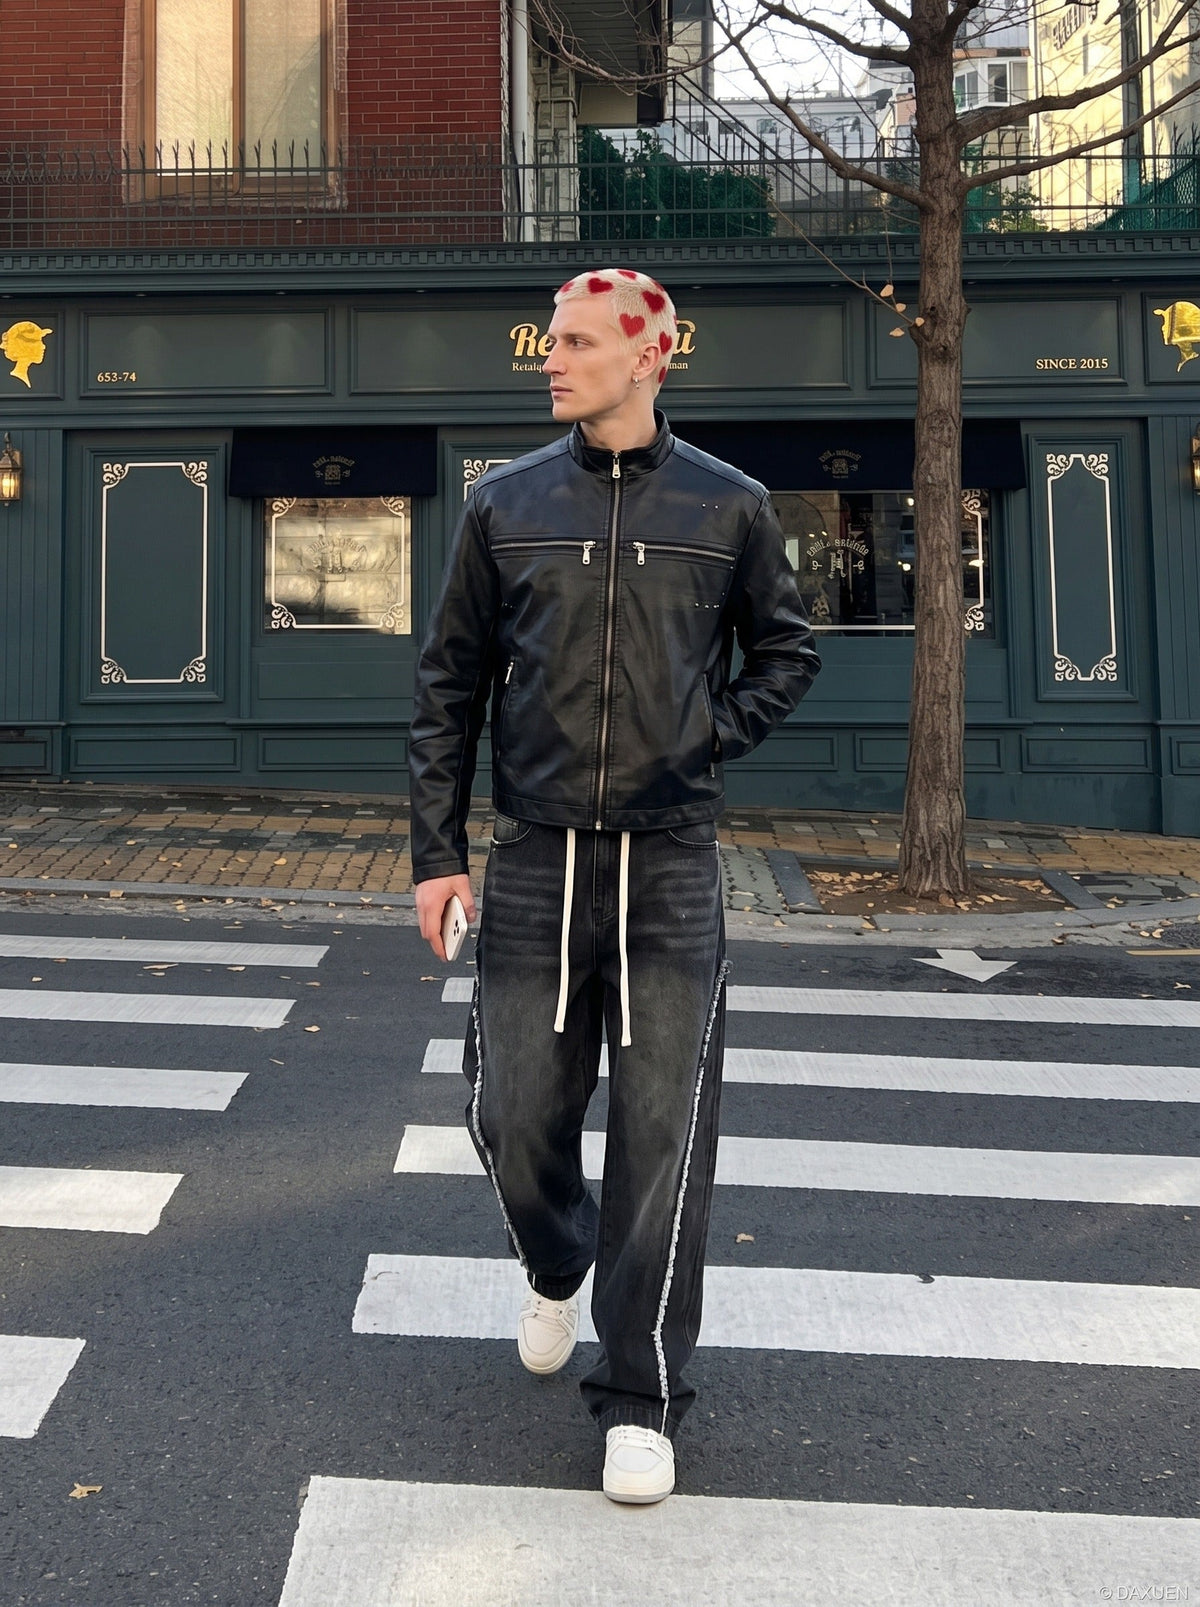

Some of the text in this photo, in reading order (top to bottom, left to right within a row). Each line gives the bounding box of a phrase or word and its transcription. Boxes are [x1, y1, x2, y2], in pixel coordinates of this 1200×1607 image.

[509, 322, 551, 357] Re
[512, 361, 689, 374] Retalq man
[1036, 358, 1109, 370] SINCE 2015
[97, 371, 137, 383] 653-74
